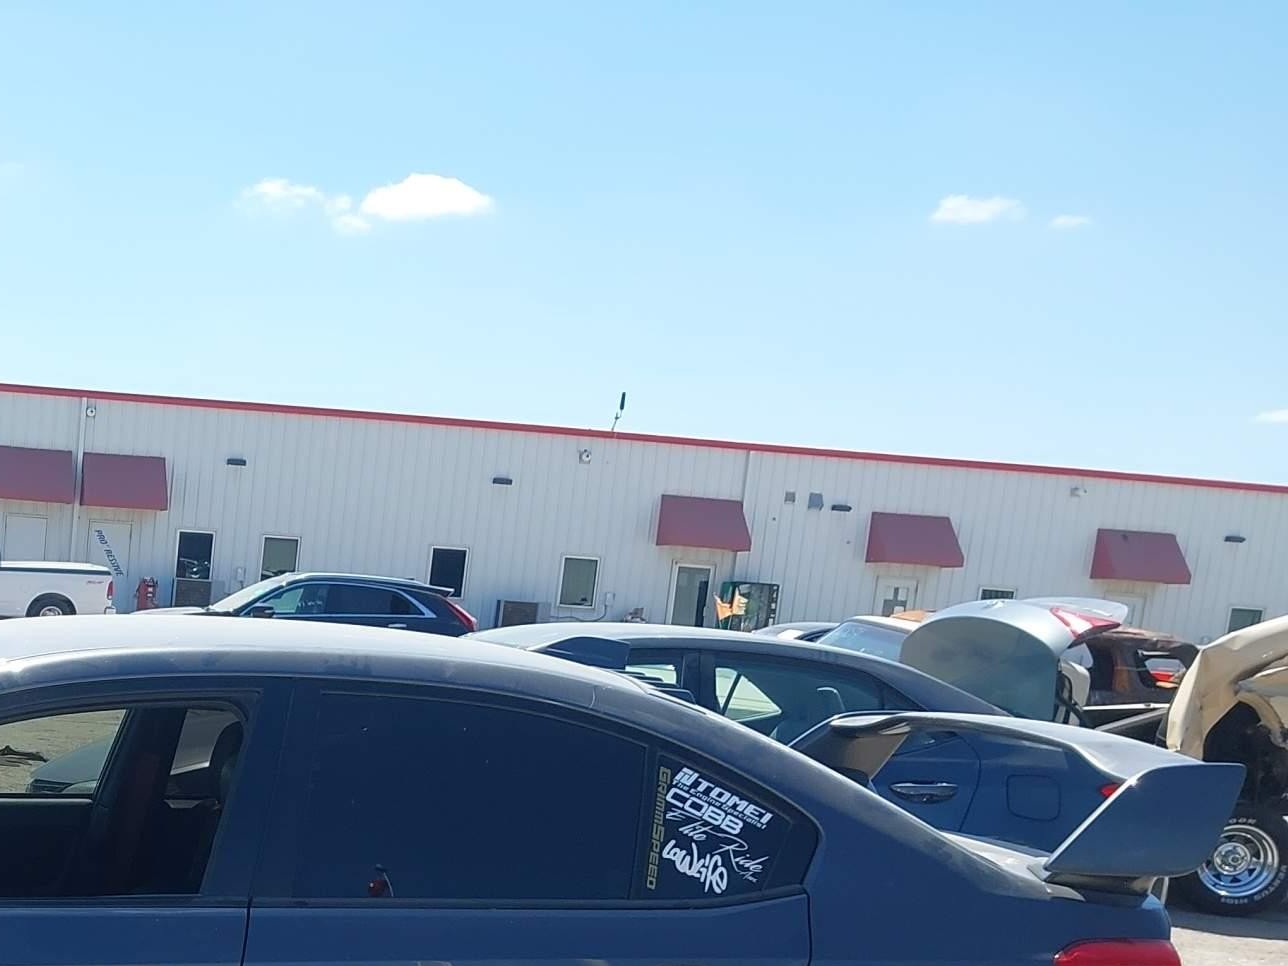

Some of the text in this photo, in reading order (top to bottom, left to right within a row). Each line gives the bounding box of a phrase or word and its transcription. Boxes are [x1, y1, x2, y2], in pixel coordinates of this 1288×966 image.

[94, 529, 124, 577] PRORESSIVE
[666, 787, 744, 834] COBB
[672, 779, 767, 829] The Engine Specialist
[696, 778, 773, 824] TOMEI
[712, 829, 769, 872] Ride
